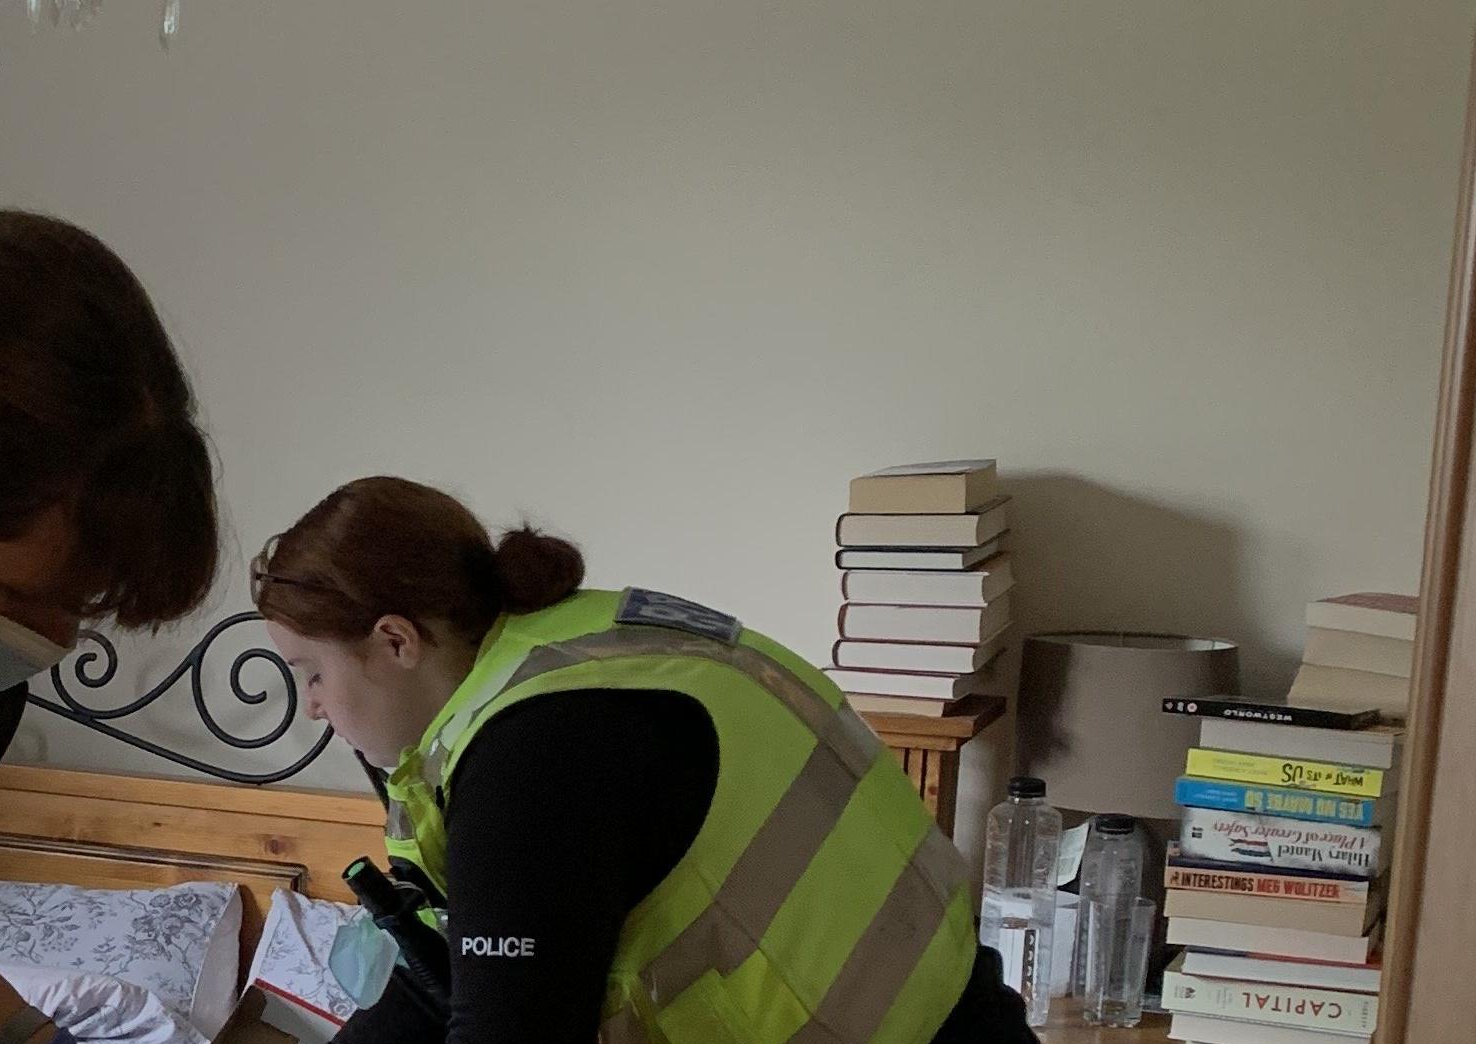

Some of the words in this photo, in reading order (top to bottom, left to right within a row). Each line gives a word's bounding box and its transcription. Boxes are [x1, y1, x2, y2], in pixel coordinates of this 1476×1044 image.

[1224, 709, 1292, 721] WESTWORLD
[1281, 763, 1304, 783] US
[1333, 772, 1363, 787] WHAT
[1252, 825, 1303, 842] Greater
[1305, 833, 1318, 844] of
[1323, 832, 1358, 849] Place
[1277, 845, 1322, 861] Mantel
[1328, 850, 1370, 867] Hilary
[1181, 872, 1254, 892] INTERESTINGS
[1257, 878, 1280, 894] MEG
[1284, 880, 1340, 899] WOLITZER
[462, 936, 536, 957] POLICE
[1242, 992, 1342, 1019] CAPITAL
